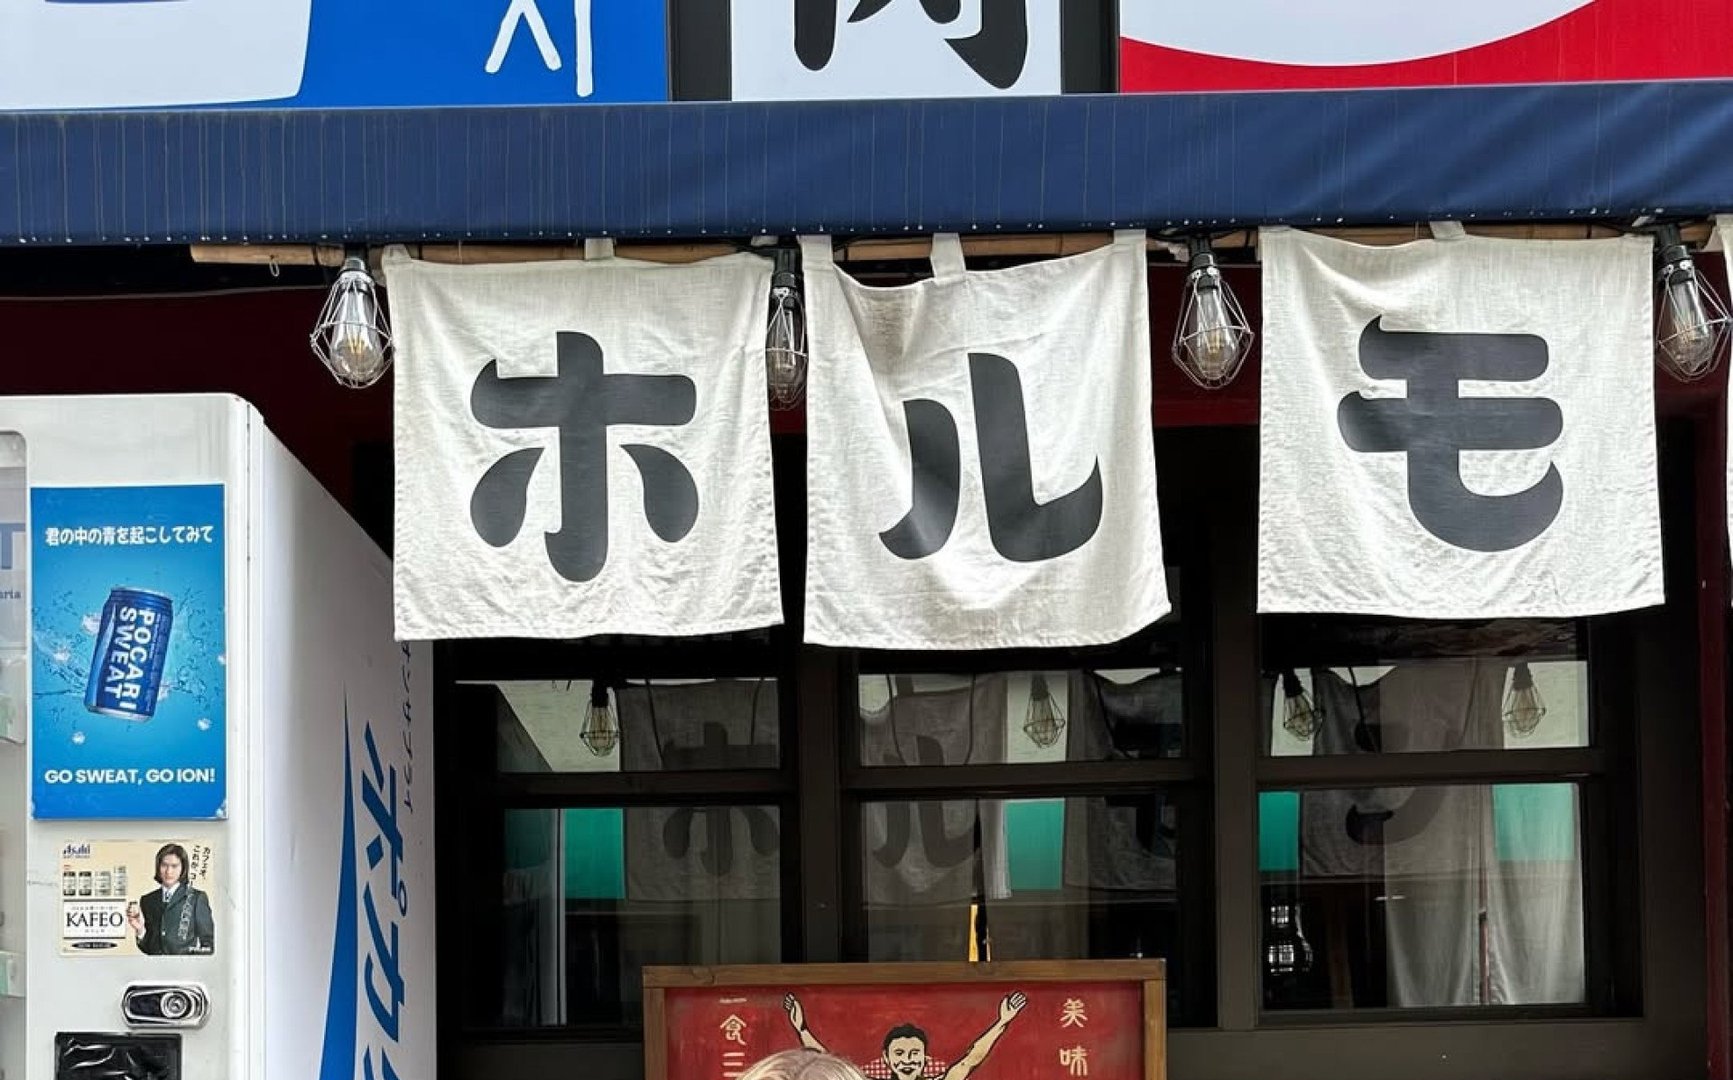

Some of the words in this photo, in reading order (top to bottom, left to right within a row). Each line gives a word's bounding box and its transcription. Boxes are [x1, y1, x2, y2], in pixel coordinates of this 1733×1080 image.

[470, 331, 699, 582] ホ
[879, 352, 1103, 562] ル
[1337, 314, 1564, 552] モ
[45, 526, 214, 546] 君の中の青を起こしてみて
[105, 606, 137, 699] SWEAT
[120, 608, 156, 711] POCARI
[45, 770, 73, 783] GO
[76, 769, 143, 786] SWEAT,
[146, 769, 174, 783] GO
[177, 768, 216, 783] ION!
[66, 911, 124, 927] KAFEO
